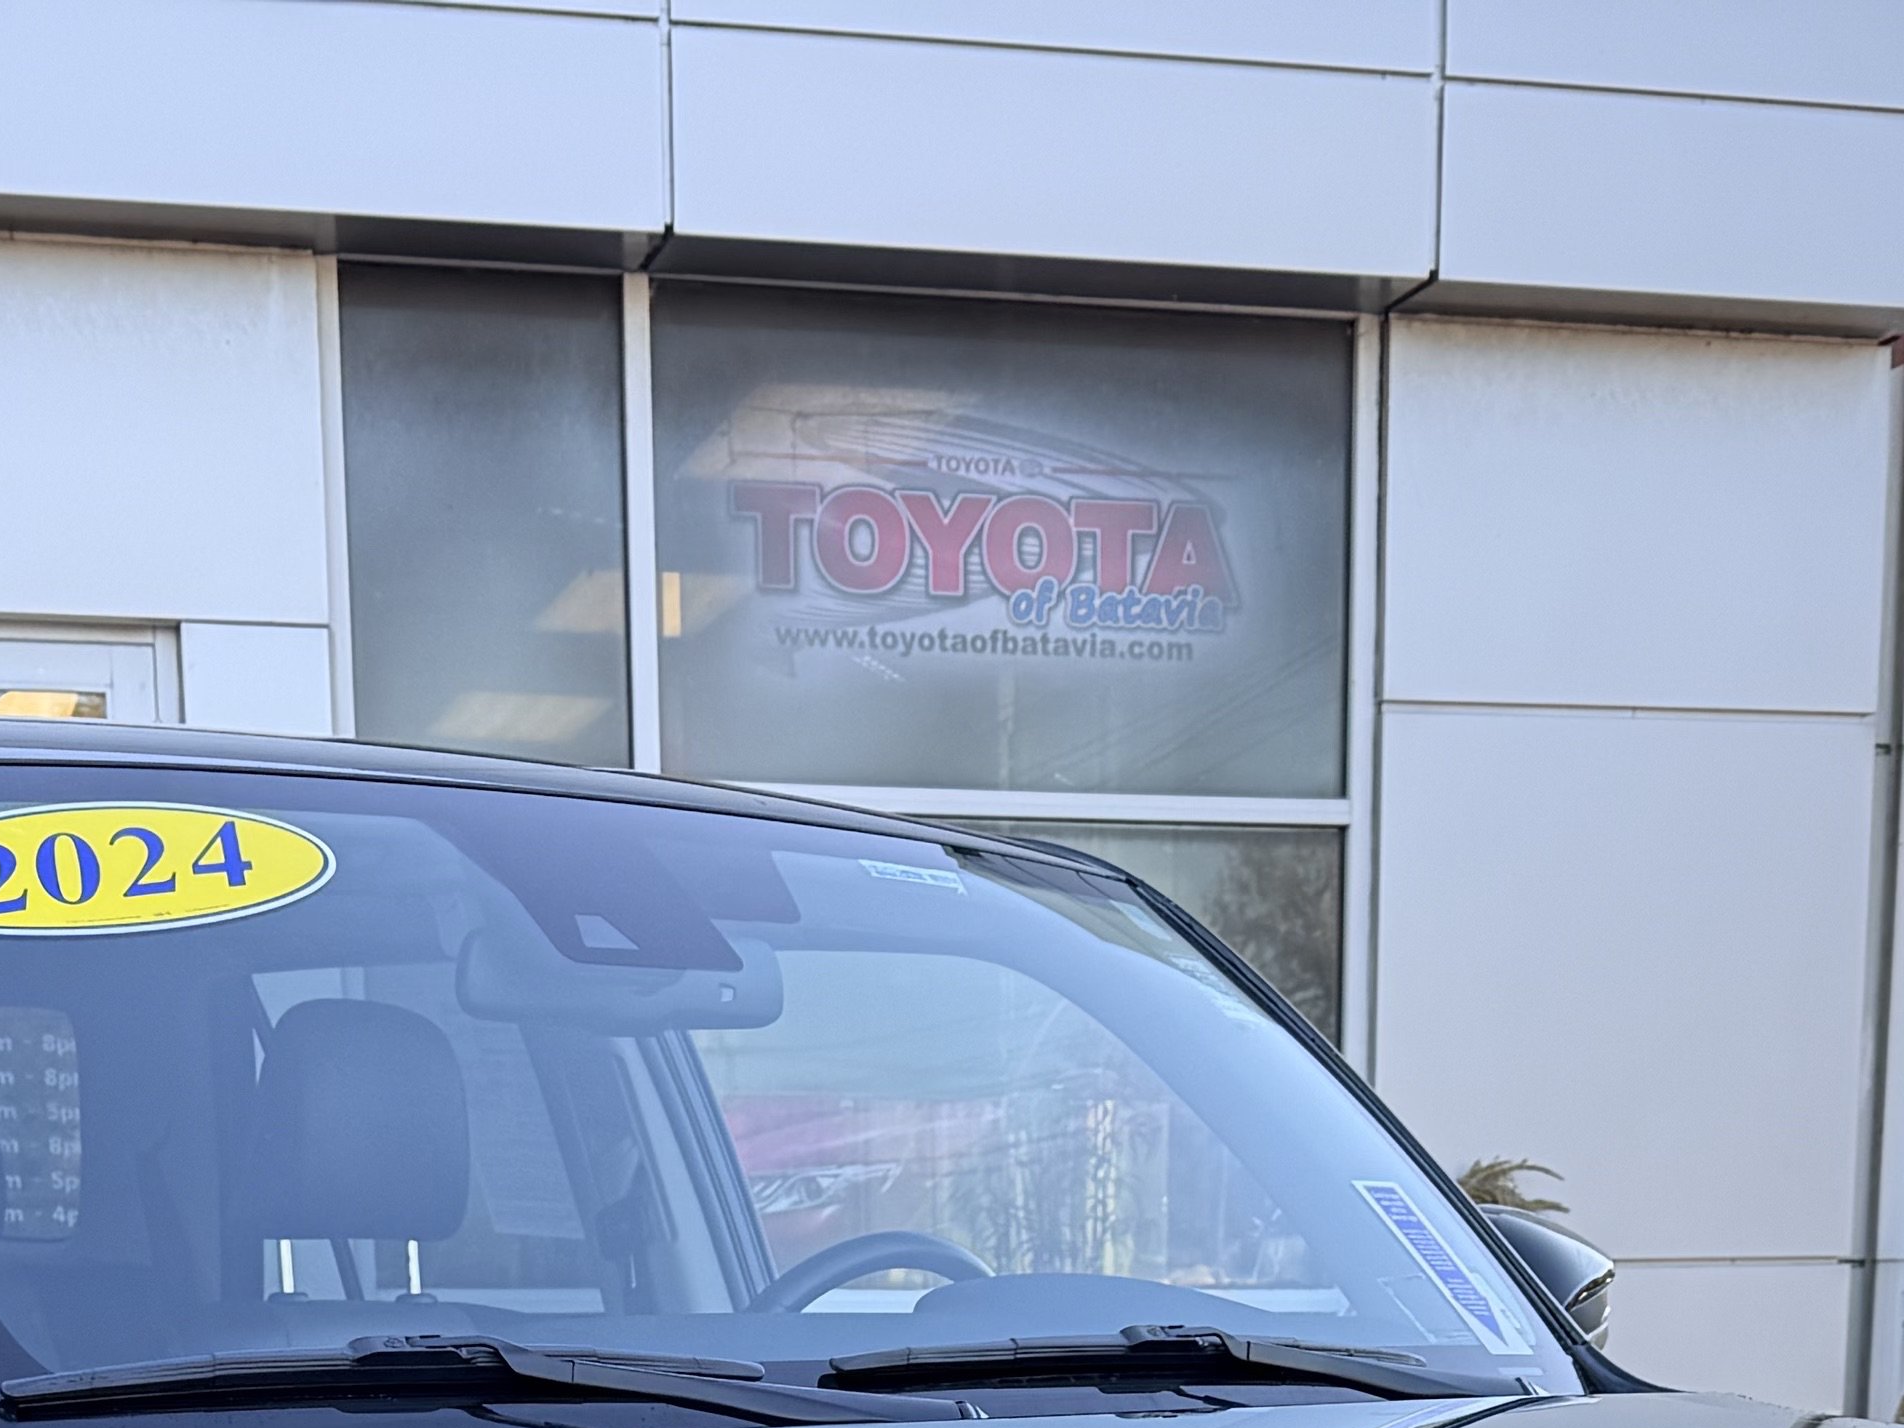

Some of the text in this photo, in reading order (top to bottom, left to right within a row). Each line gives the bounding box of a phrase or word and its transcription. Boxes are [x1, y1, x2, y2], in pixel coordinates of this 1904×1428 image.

[935, 455, 1015, 476] TOYOTA
[731, 482, 1240, 608] TOYOTA
[1012, 577, 1225, 631] of Batavia
[775, 625, 1194, 662] www.toyotaofbatavia.com
